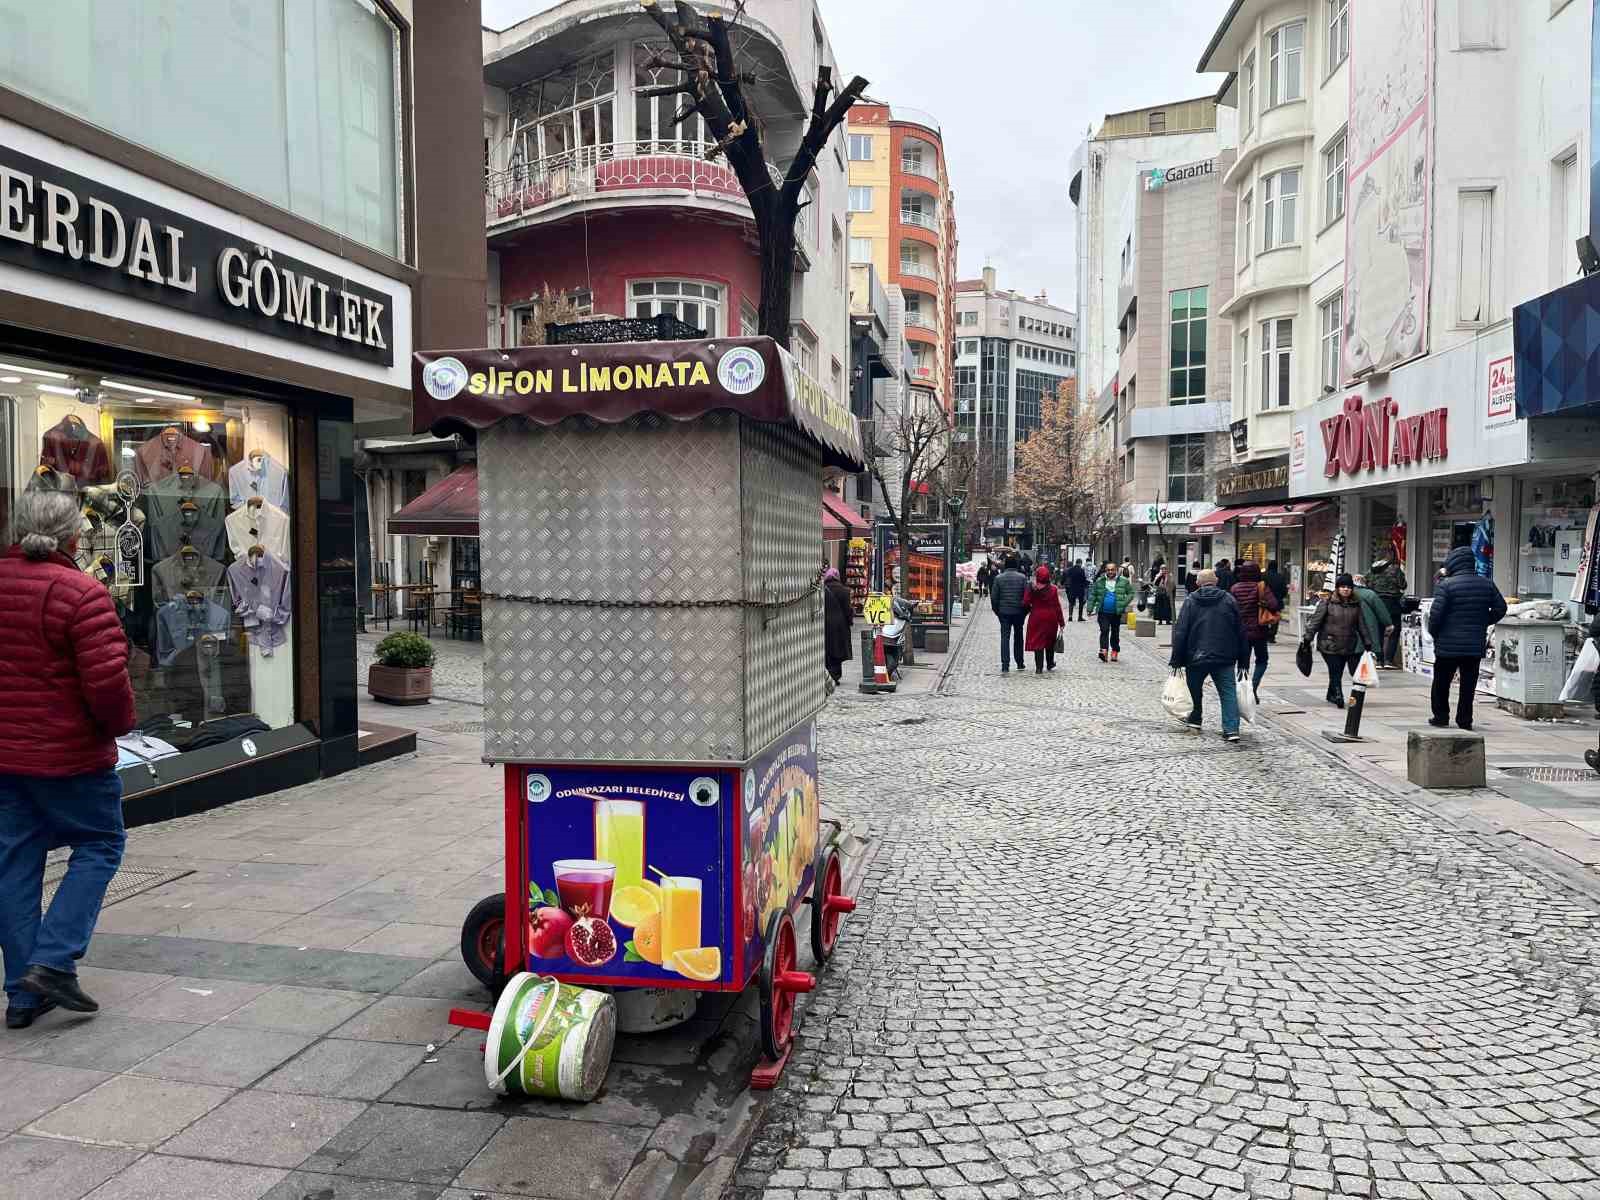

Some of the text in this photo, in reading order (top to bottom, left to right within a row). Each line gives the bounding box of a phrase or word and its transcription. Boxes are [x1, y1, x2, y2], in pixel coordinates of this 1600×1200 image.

[1165, 159, 1213, 183] Garanti
[0, 165, 387, 350] ERDAL GÖMLEK
[467, 366, 552, 395] SİFON
[562, 361, 710, 392] LİMONATA
[1491, 366, 1505, 388] 24
[1319, 394, 1393, 478] YÖN
[1390, 407, 1448, 467] AVM
[1159, 508, 1192, 520] Garanti
[869, 610, 885, 624] VC
[555, 786, 623, 799] ODUNPAZARI
[626, 786, 685, 802] BELEDİYESİ
